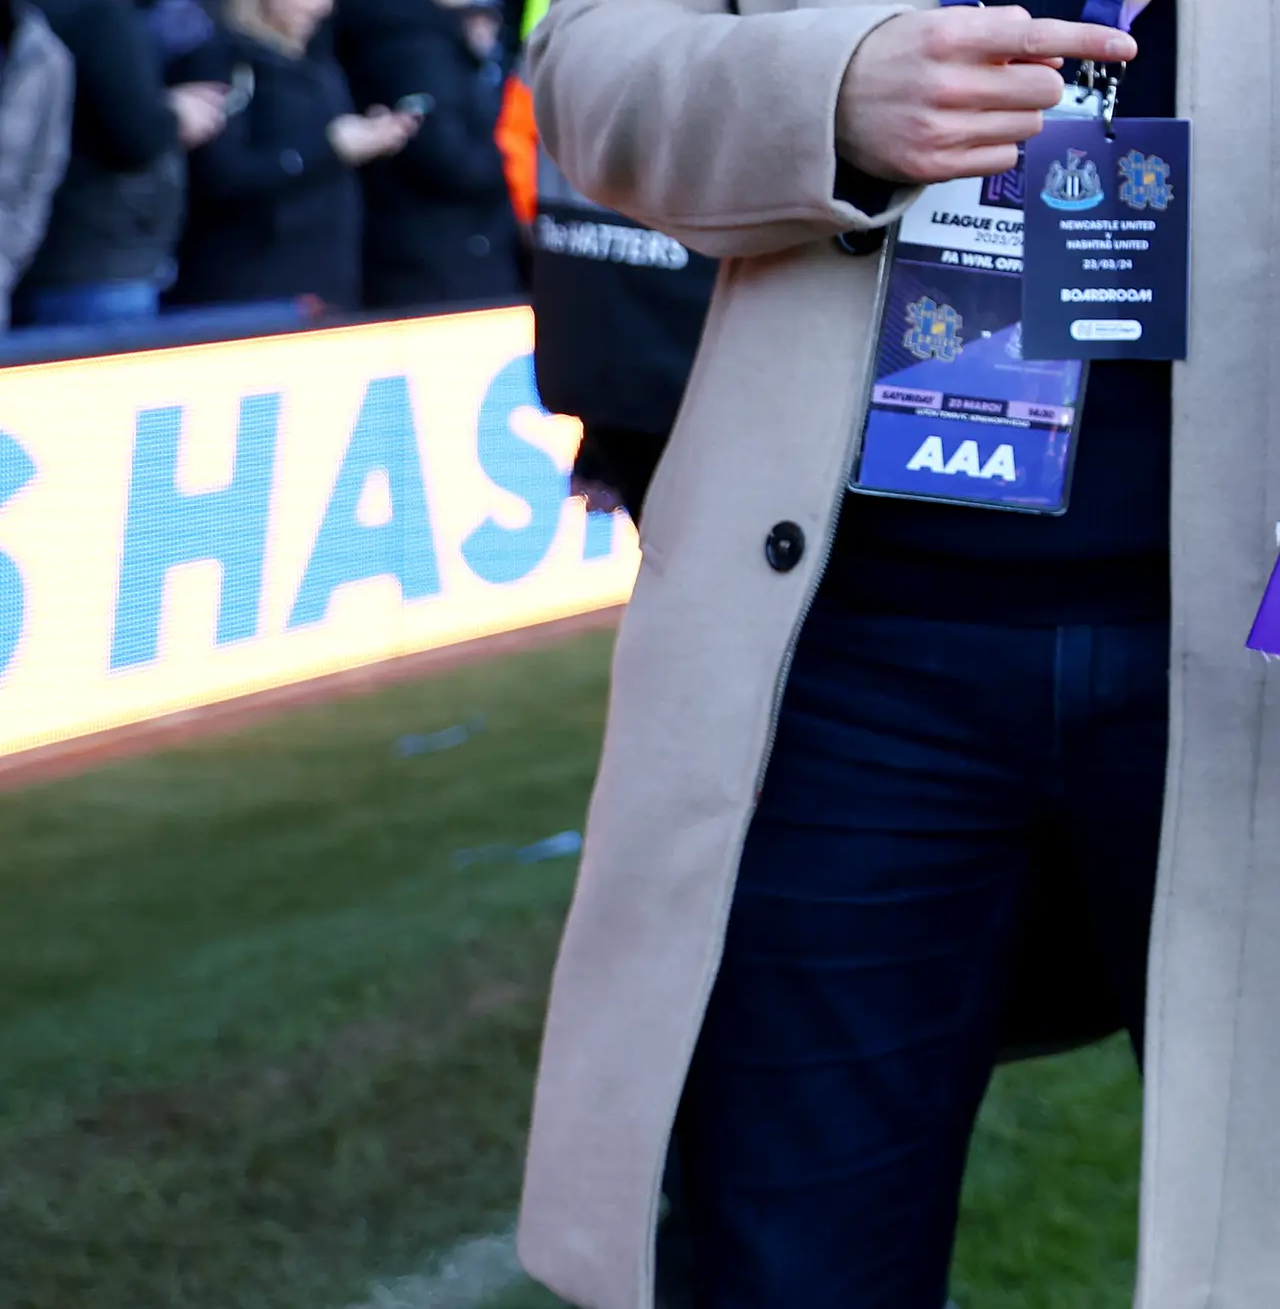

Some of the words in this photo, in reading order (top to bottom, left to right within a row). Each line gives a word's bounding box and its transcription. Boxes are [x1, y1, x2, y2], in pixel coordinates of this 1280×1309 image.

[931, 211, 992, 230] LEAGUE
[1059, 219, 1119, 231] NEWCASTLE
[1121, 220, 1156, 231] UNITED
[1066, 239, 1113, 250] HASHTAG
[1114, 239, 1150, 251] UNITED
[941, 250, 959, 264] FA
[962, 251, 995, 269] WNL
[1060, 288, 1153, 302] BOARDROOM
[905, 435, 1016, 482] AAA
